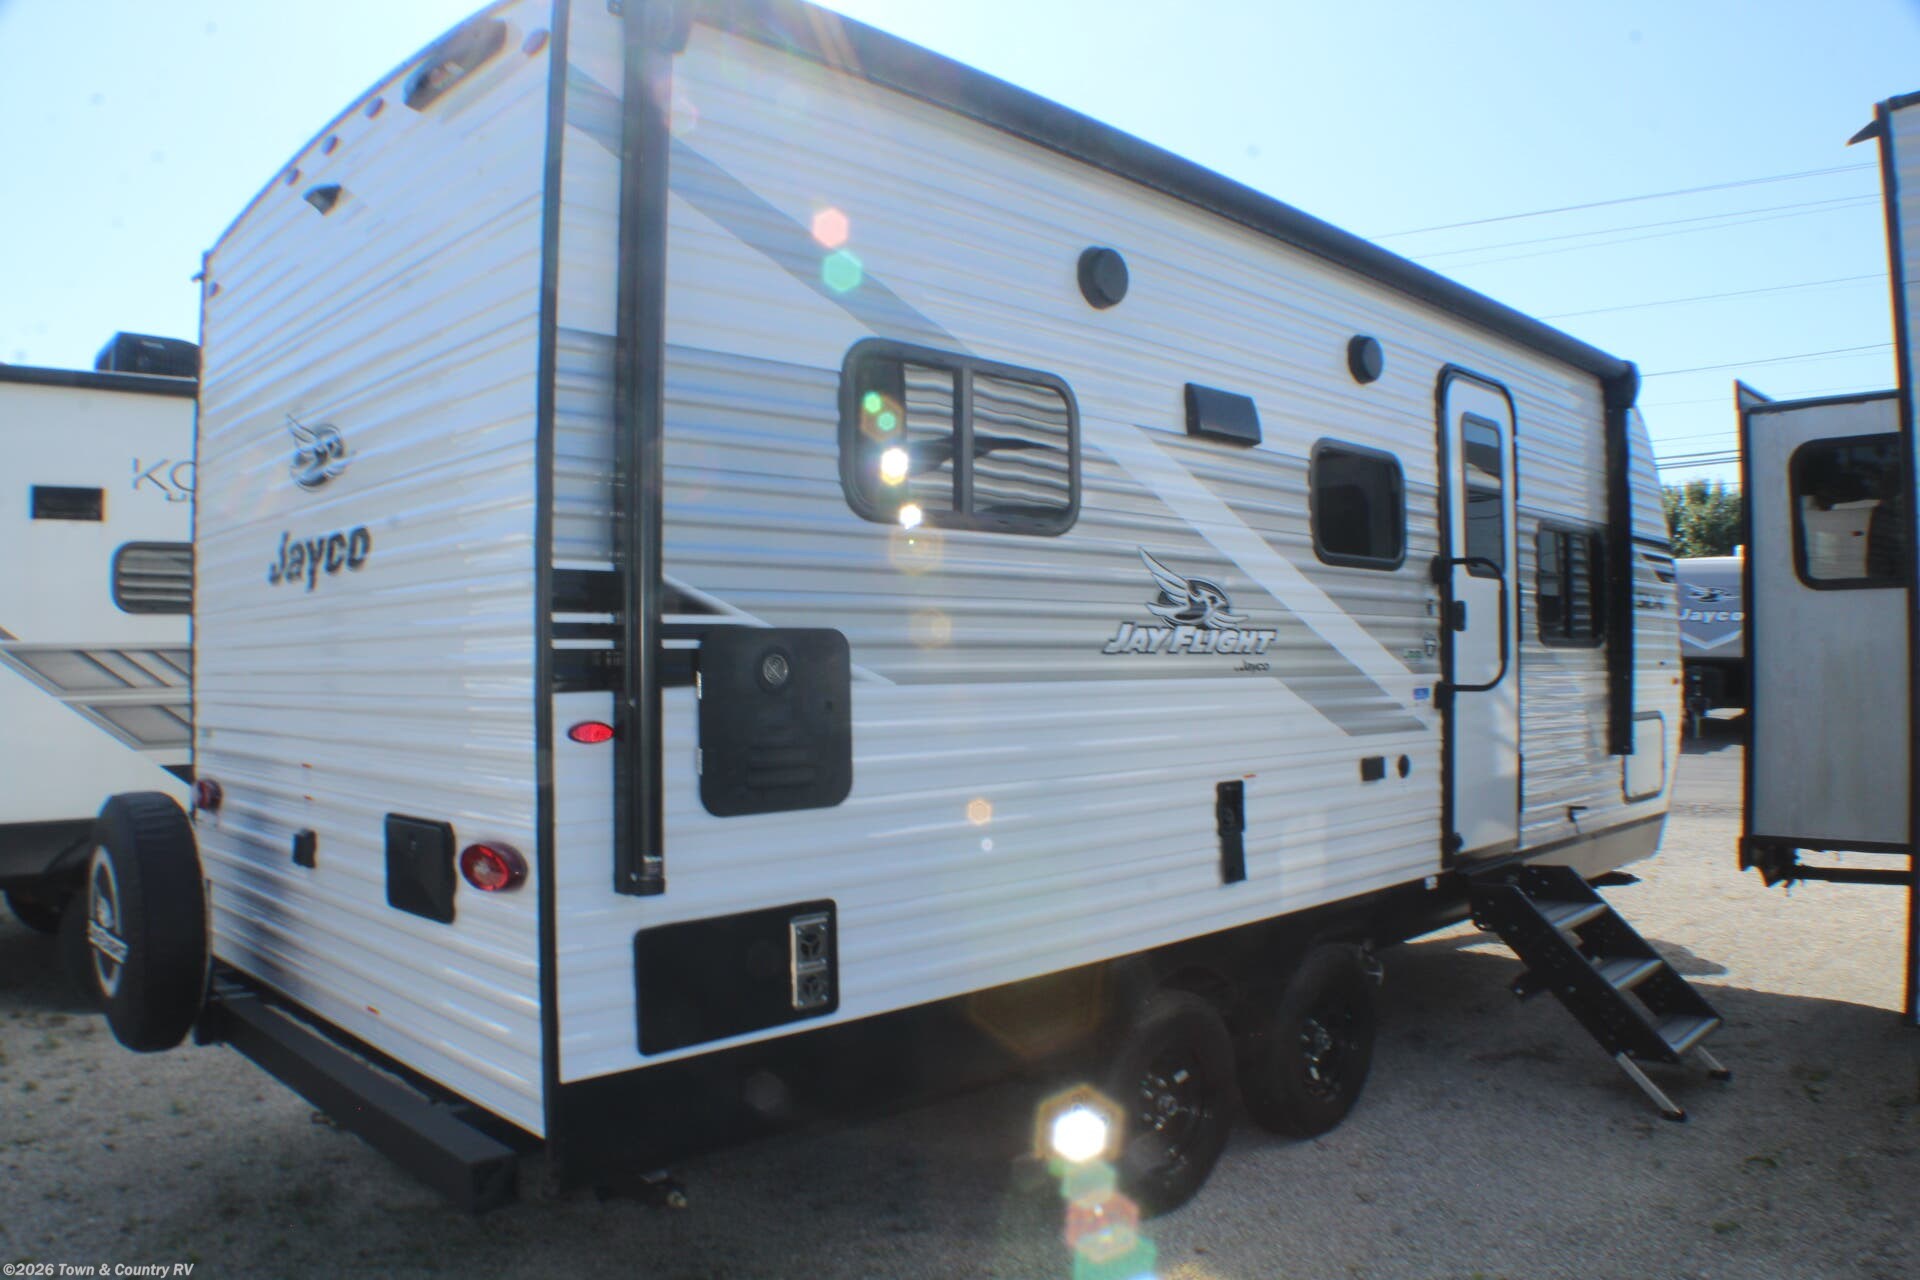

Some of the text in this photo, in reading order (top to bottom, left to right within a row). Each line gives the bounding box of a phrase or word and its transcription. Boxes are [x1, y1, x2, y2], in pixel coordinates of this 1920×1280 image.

[267, 526, 371, 593] Jayco
[1680, 608, 1745, 624] Jayco
[1102, 621, 1278, 655] JAY FLIGHT
